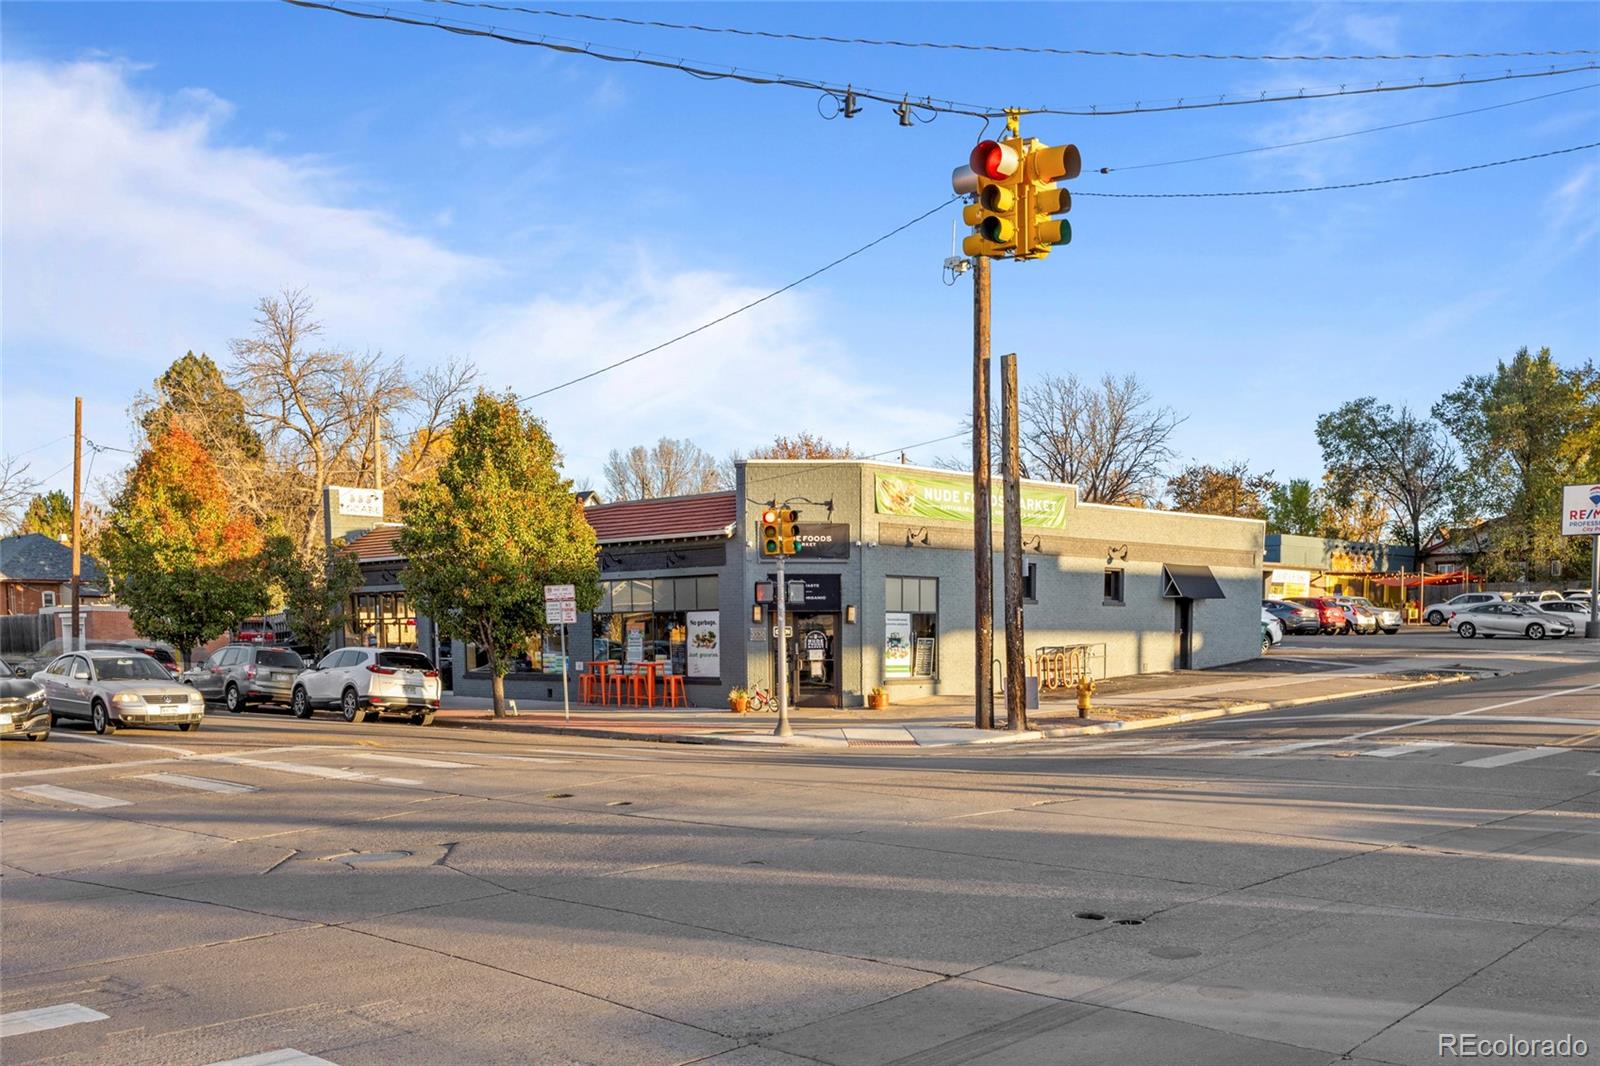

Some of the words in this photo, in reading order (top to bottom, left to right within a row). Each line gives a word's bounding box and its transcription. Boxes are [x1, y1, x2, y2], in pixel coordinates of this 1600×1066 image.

[924, 488, 960, 503] NUDE
[963, 492, 1004, 507] FDS
[1019, 496, 1057, 511] ARKET
[802, 535, 832, 543] FOODS
